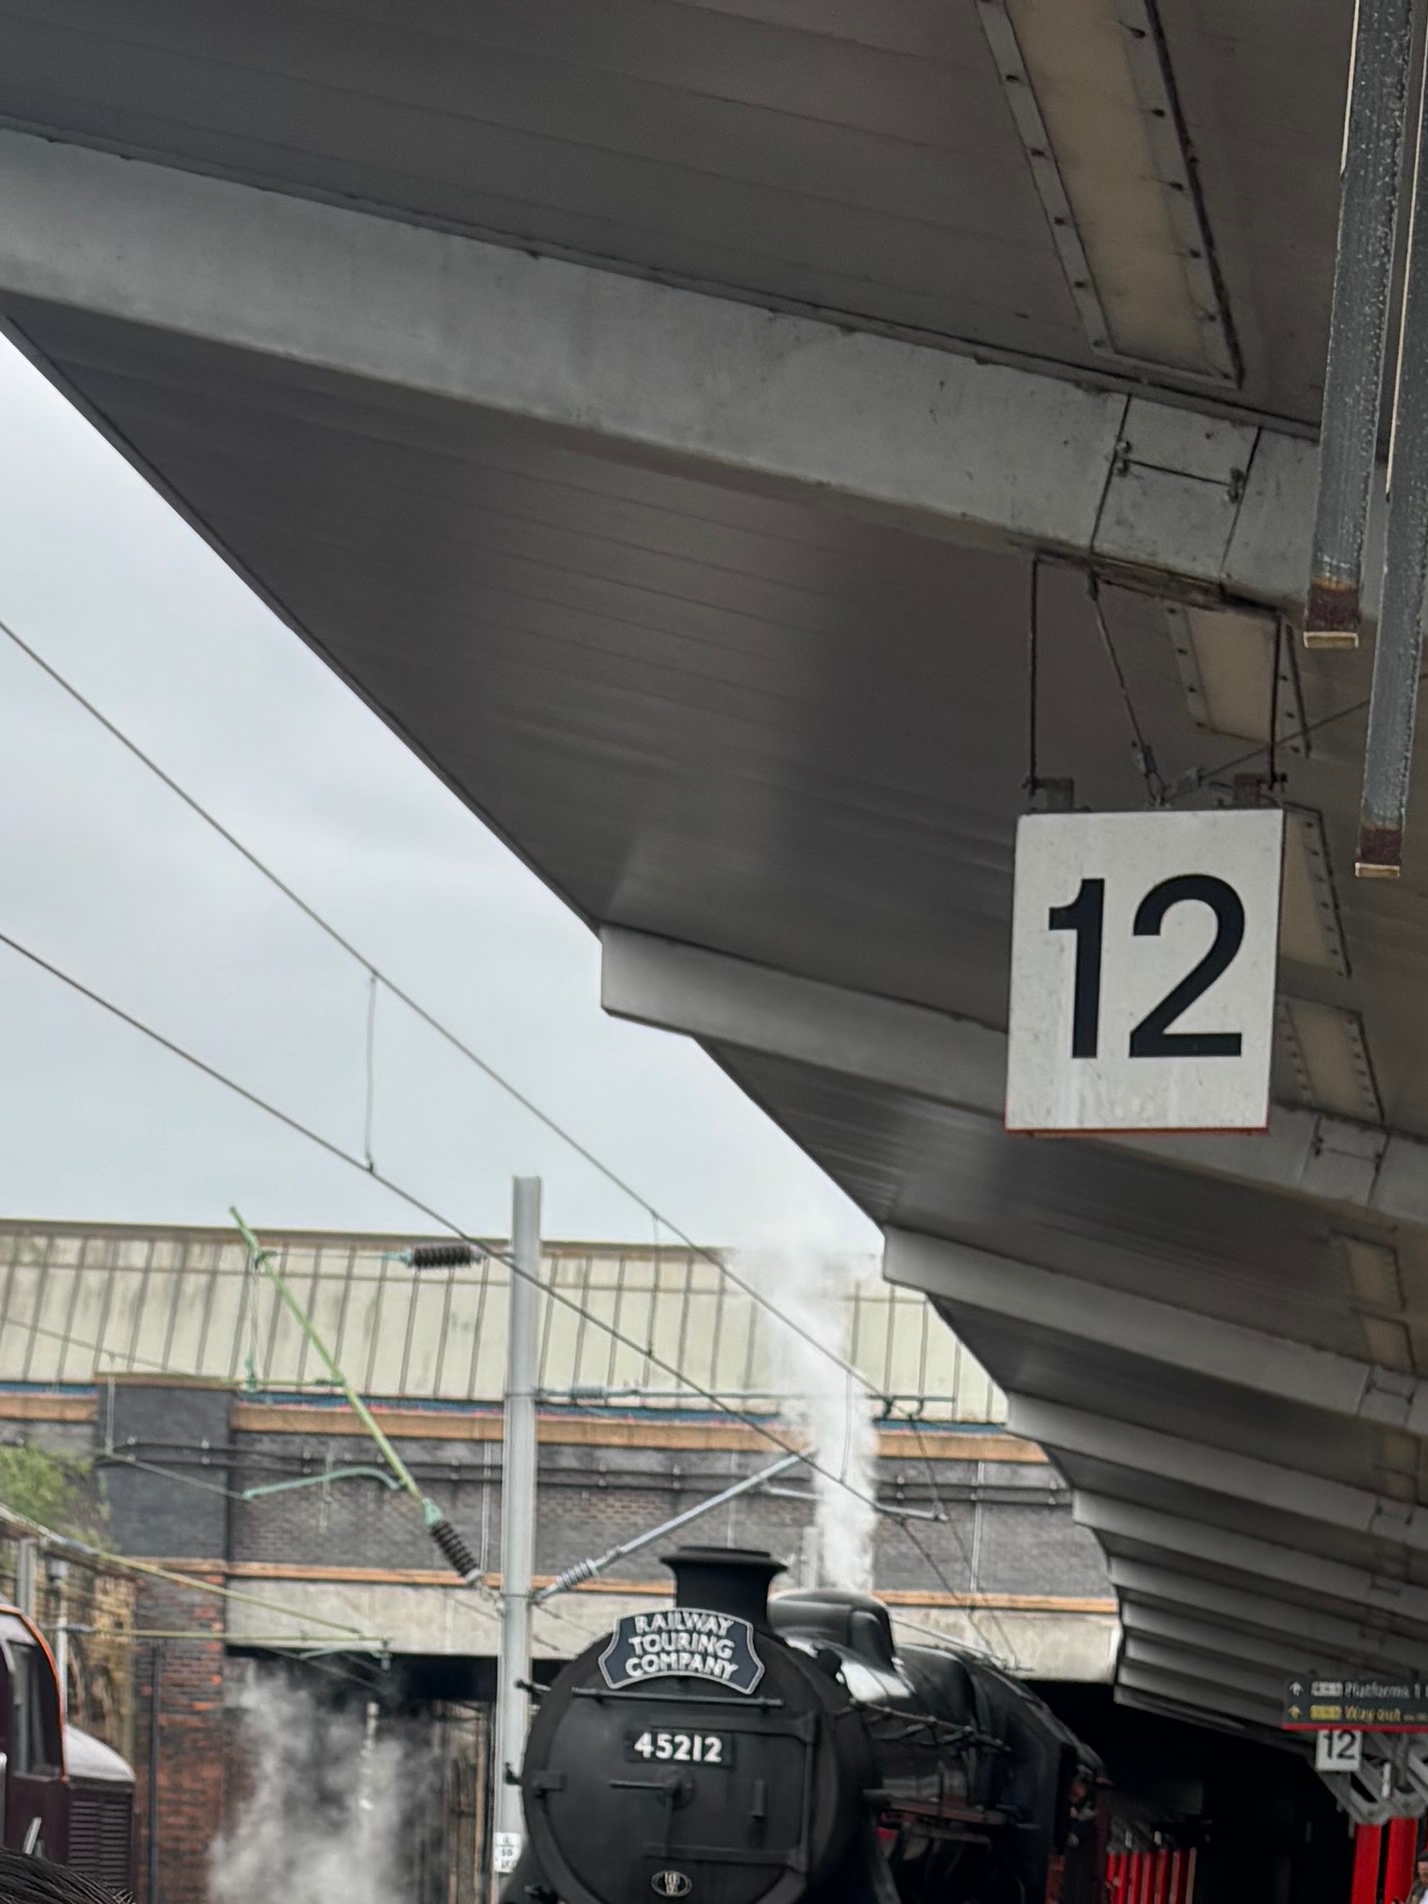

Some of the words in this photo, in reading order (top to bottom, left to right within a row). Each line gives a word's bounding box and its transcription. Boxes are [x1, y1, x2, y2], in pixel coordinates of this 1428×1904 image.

[1048, 873, 1245, 1059] 12
[634, 1612, 734, 1637] RAILWAY
[628, 1632, 735, 1660] TOURING
[625, 1652, 739, 1681] COMPANY
[1345, 1681, 1410, 1699] Platforms
[1344, 1705, 1374, 1723] Way
[1377, 1708, 1401, 1722] out
[634, 1732, 722, 1763] 45212
[1324, 1731, 1356, 1760] 12
